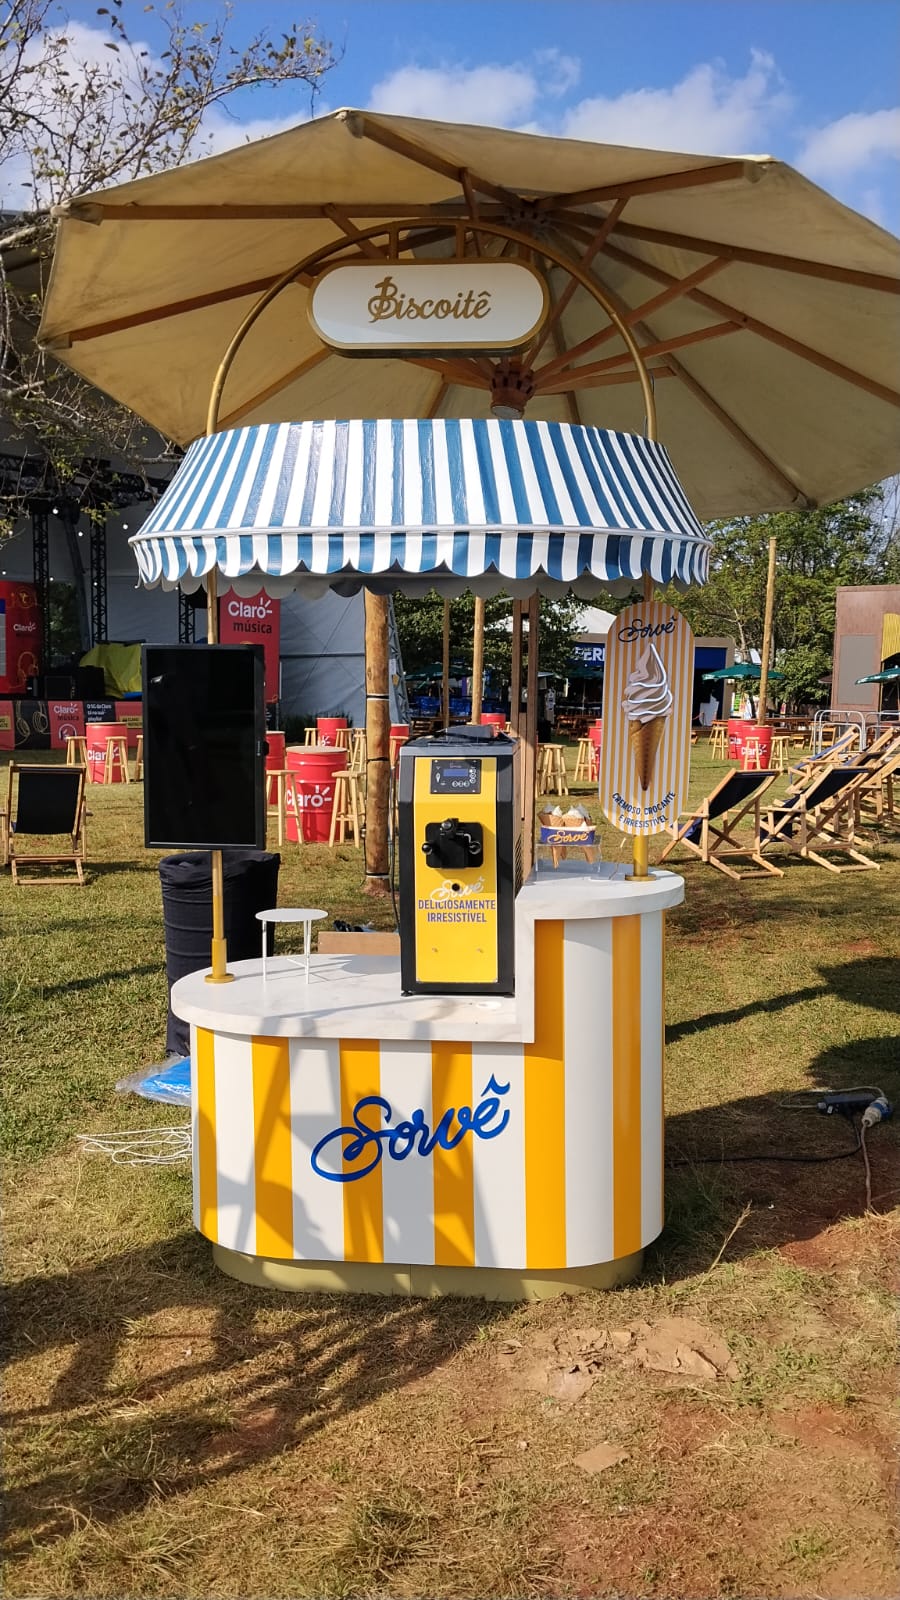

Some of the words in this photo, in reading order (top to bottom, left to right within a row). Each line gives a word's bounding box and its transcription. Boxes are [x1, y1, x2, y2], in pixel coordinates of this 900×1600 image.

[367, 276, 492, 323] Biscoitê
[228, 598, 272, 619] Claro
[233, 620, 273, 634] música
[618, 615, 677, 643] Sorvê
[54, 704, 77, 714] Claro
[644, 791, 676, 815] CROCANTE
[418, 900, 497, 910] DELICIOSAMENTE
[427, 909, 488, 922] IRRESISTÍVEL
[311, 1073, 510, 1182] Sorvê
